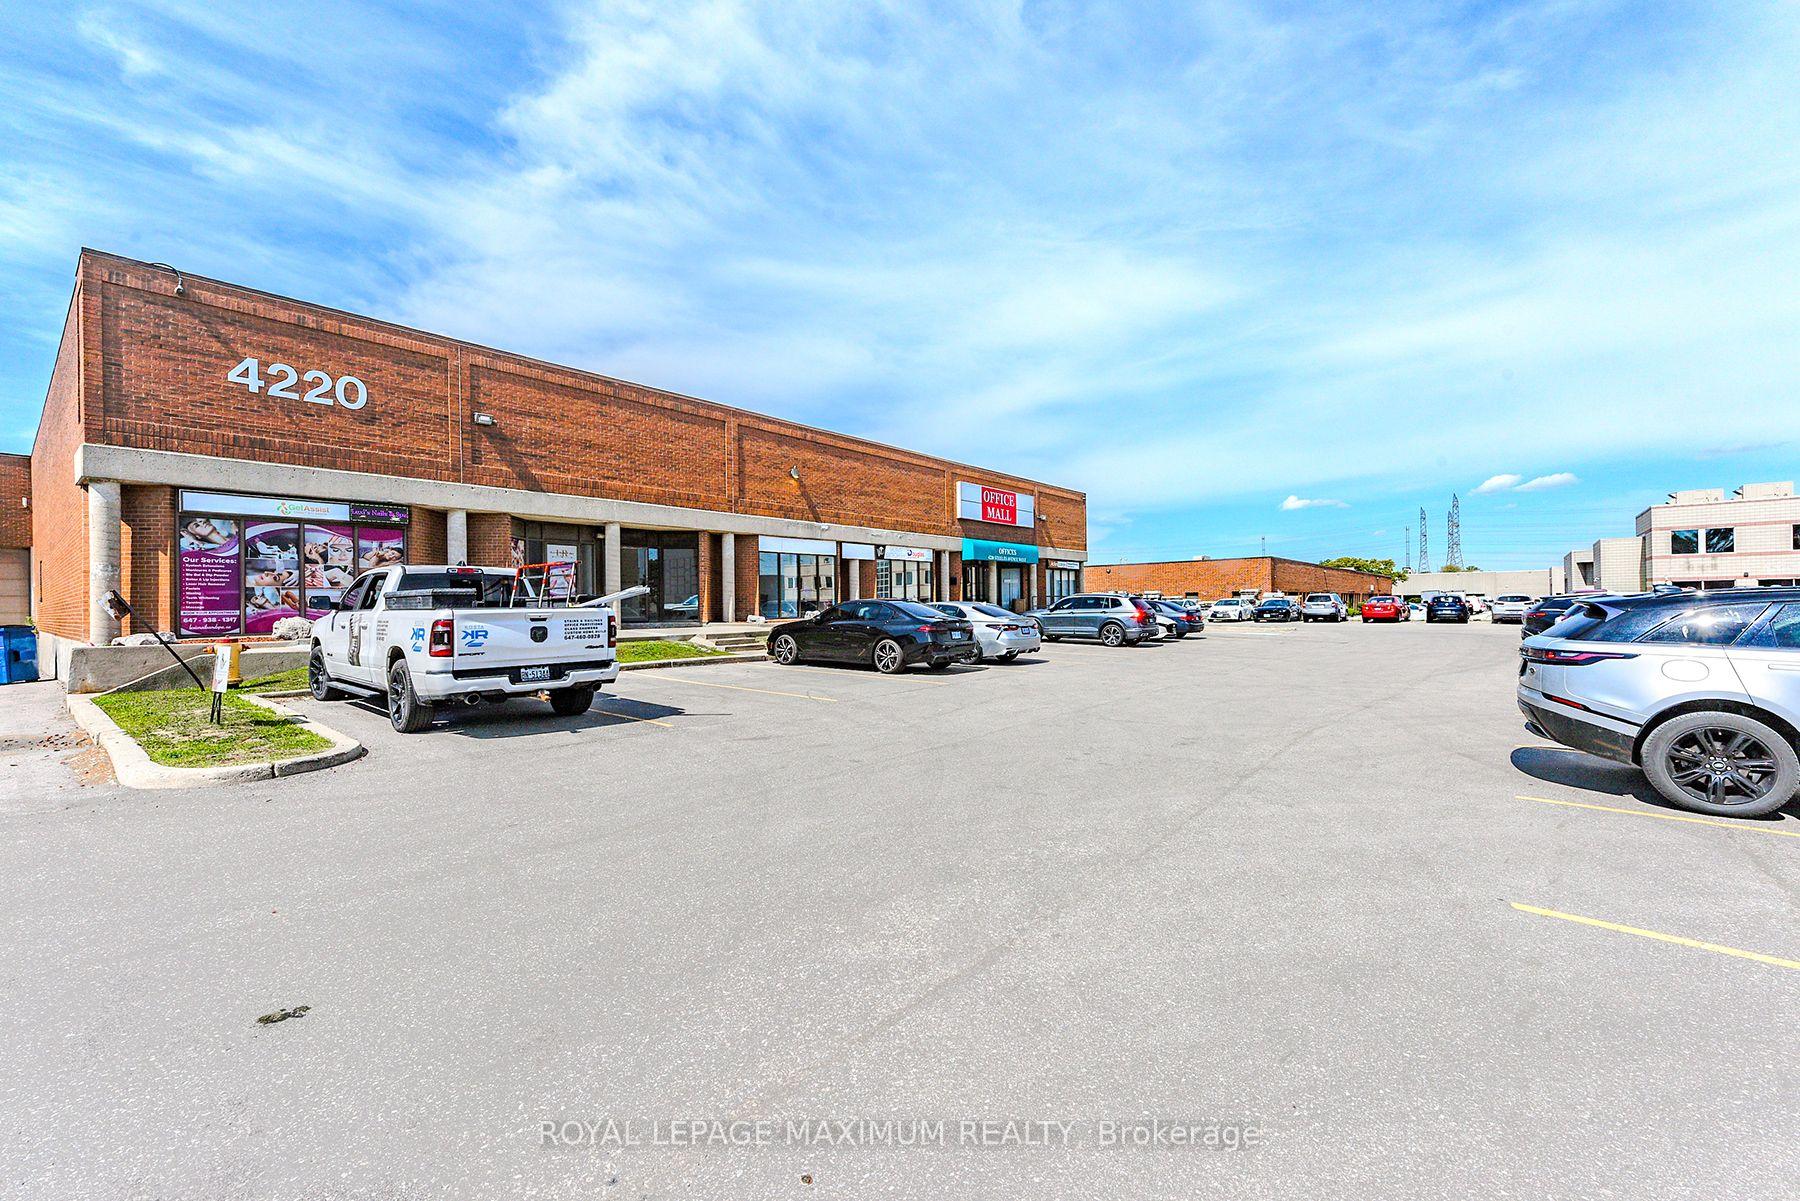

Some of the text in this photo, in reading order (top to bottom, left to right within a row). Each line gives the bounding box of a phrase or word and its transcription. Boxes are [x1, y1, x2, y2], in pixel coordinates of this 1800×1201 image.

[227, 357, 368, 410] 4220
[983, 490, 1015, 507] OFFICE
[987, 506, 1012, 522] MALL
[998, 547, 1017, 556] OFFICES
